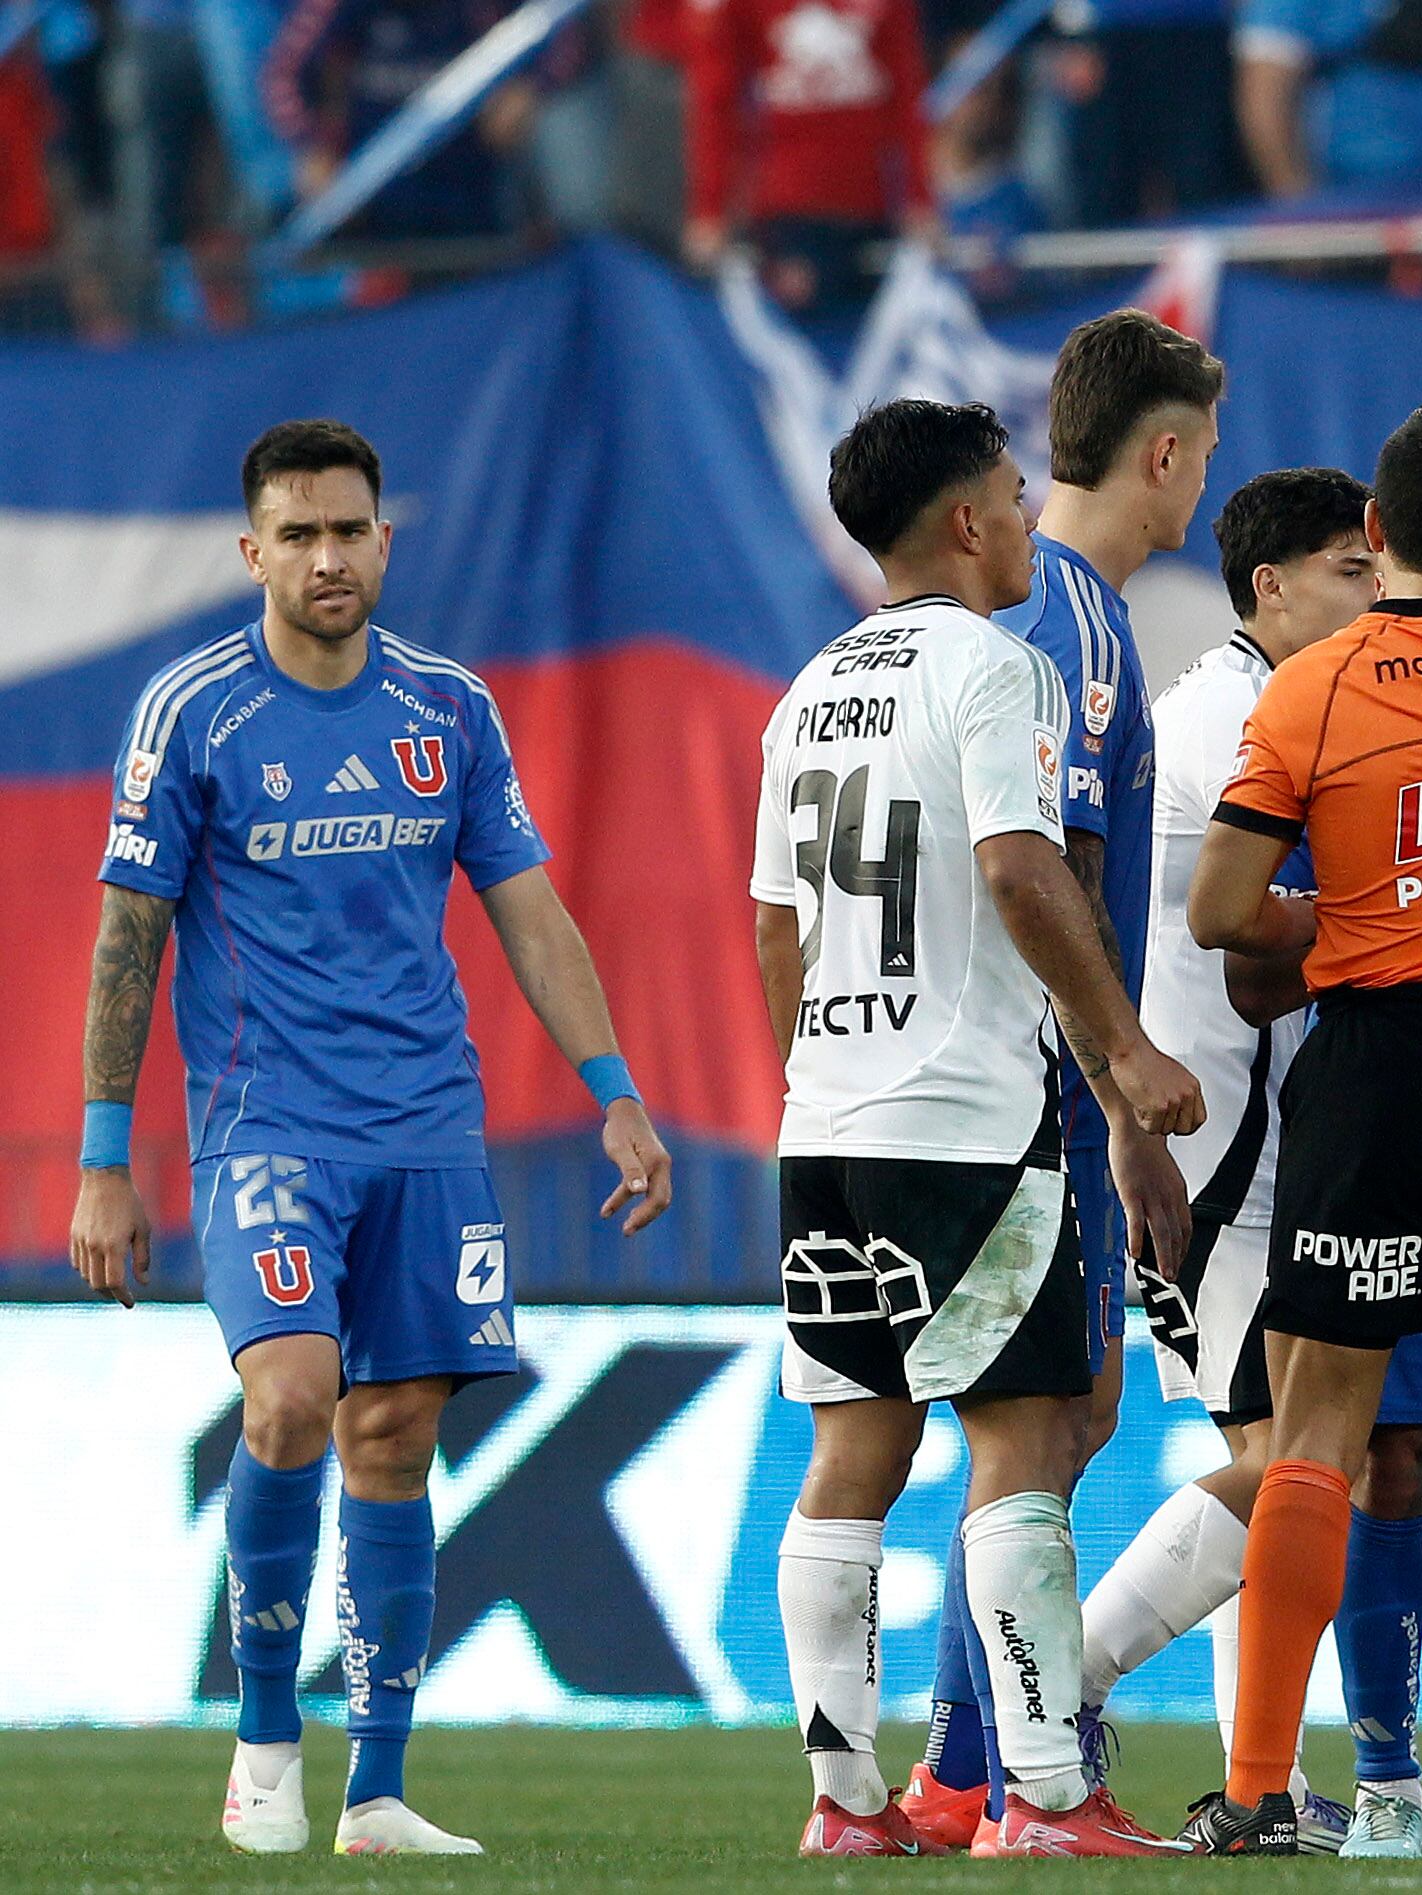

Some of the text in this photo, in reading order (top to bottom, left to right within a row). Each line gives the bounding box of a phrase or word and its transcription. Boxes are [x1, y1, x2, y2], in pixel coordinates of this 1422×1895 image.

[209, 687, 277, 749] MACHBANK
[380, 679, 457, 728] MACHBAN
[796, 696, 896, 747] PIZARRO
[295, 818, 447, 852] JUGABET
[791, 764, 921, 978] 34
[231, 1154, 310, 1230] 22
[1293, 1229, 1422, 1269] POWER
[995, 1608, 1048, 1724] AutoPlanet
[923, 1702, 953, 1770] RUNNIN
[1259, 1832, 1295, 1845] balan
